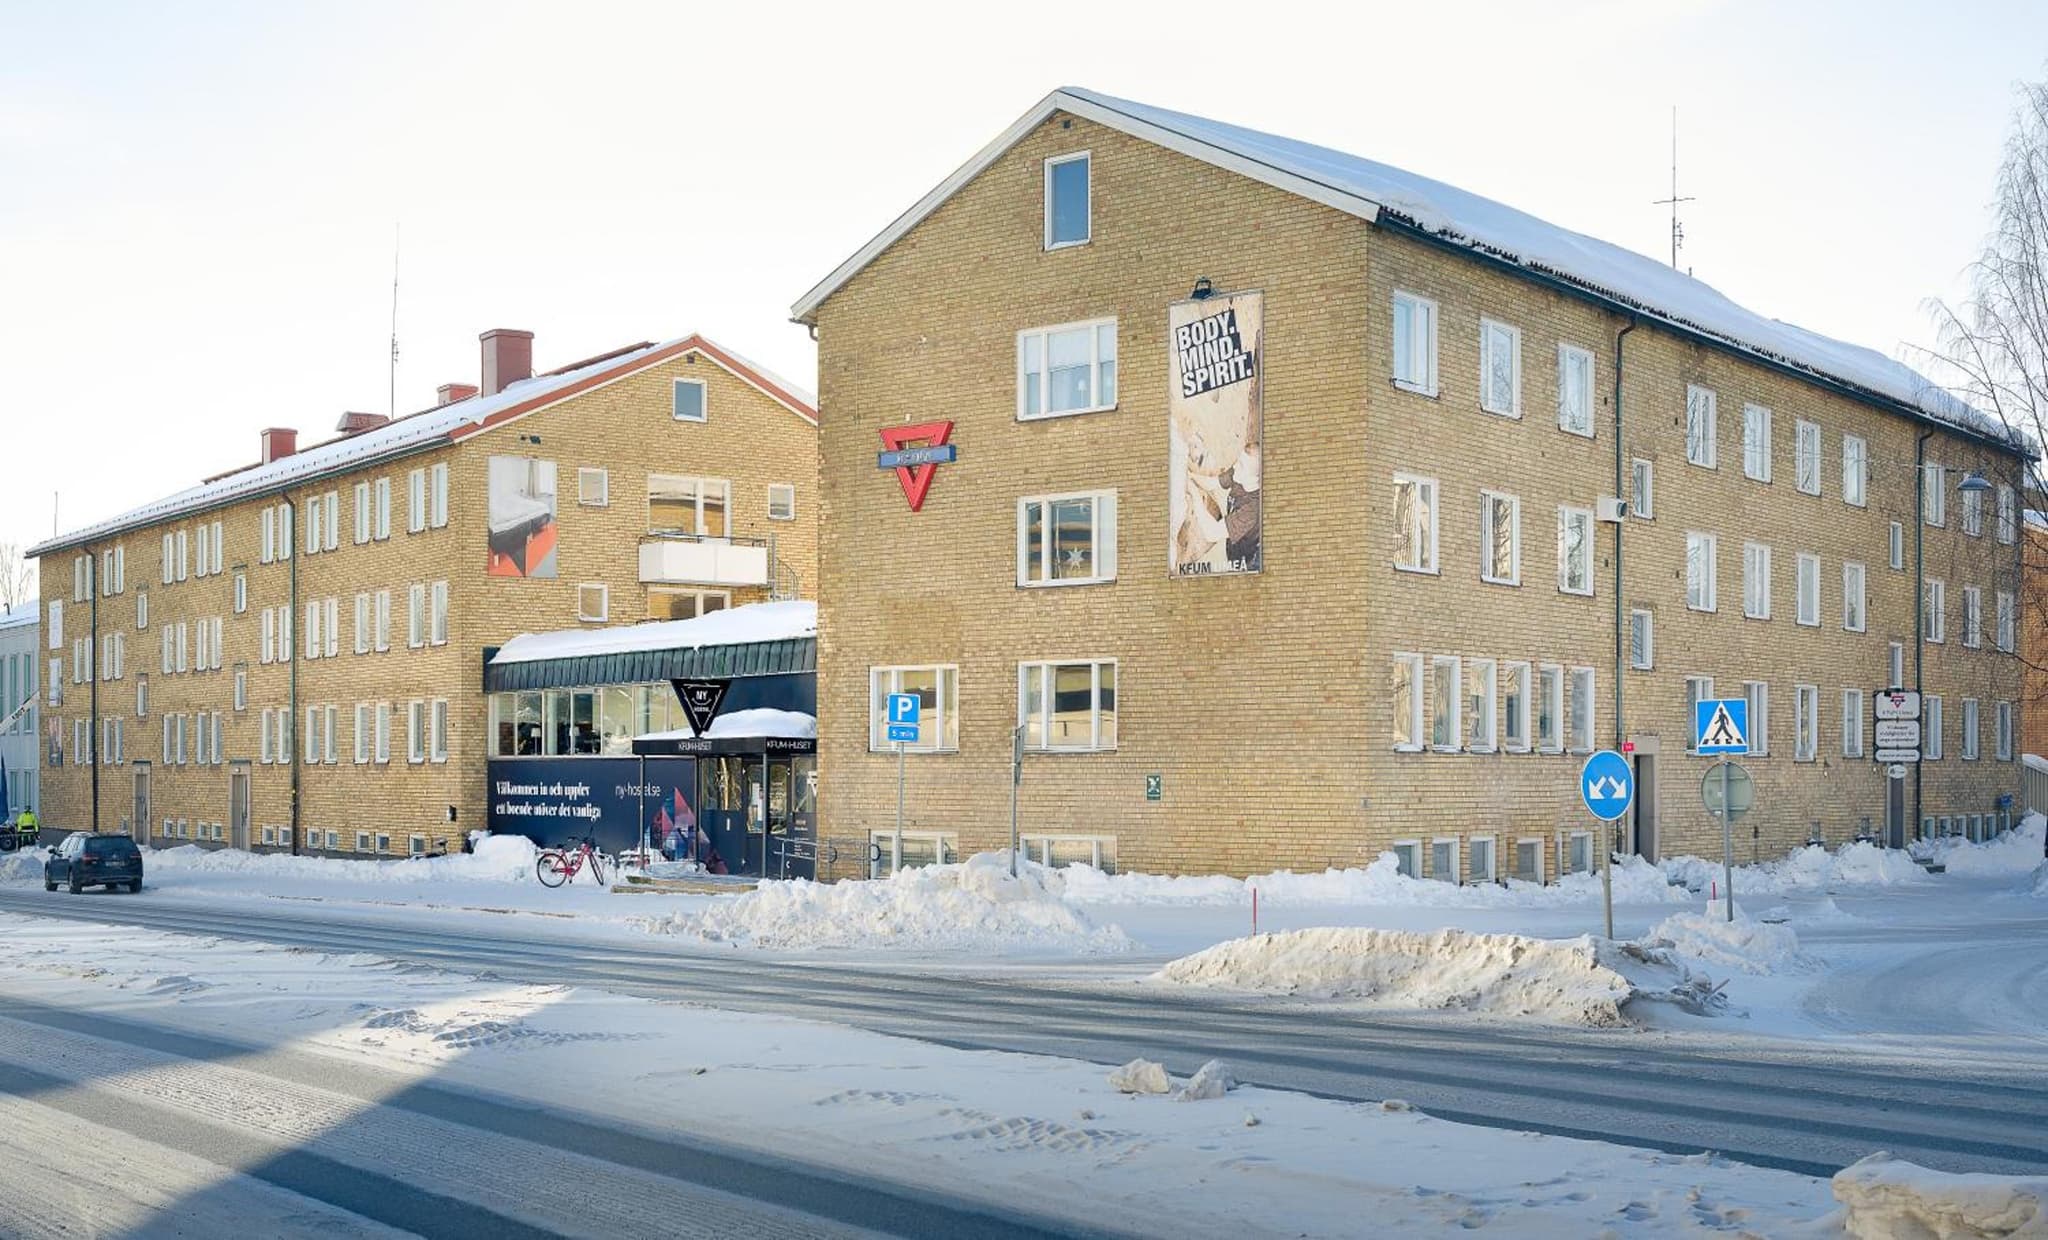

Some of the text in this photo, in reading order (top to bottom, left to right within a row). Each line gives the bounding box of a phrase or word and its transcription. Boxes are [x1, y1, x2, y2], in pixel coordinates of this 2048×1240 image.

[1177, 311, 1235, 350] BODY.
[1180, 335, 1239, 373] MIND.
[1183, 354, 1252, 396] SPIRIT.
[1179, 562, 1212, 575] KFUM
[897, 697, 913, 721] P
[766, 740, 812, 750] KFUM-HUSET
